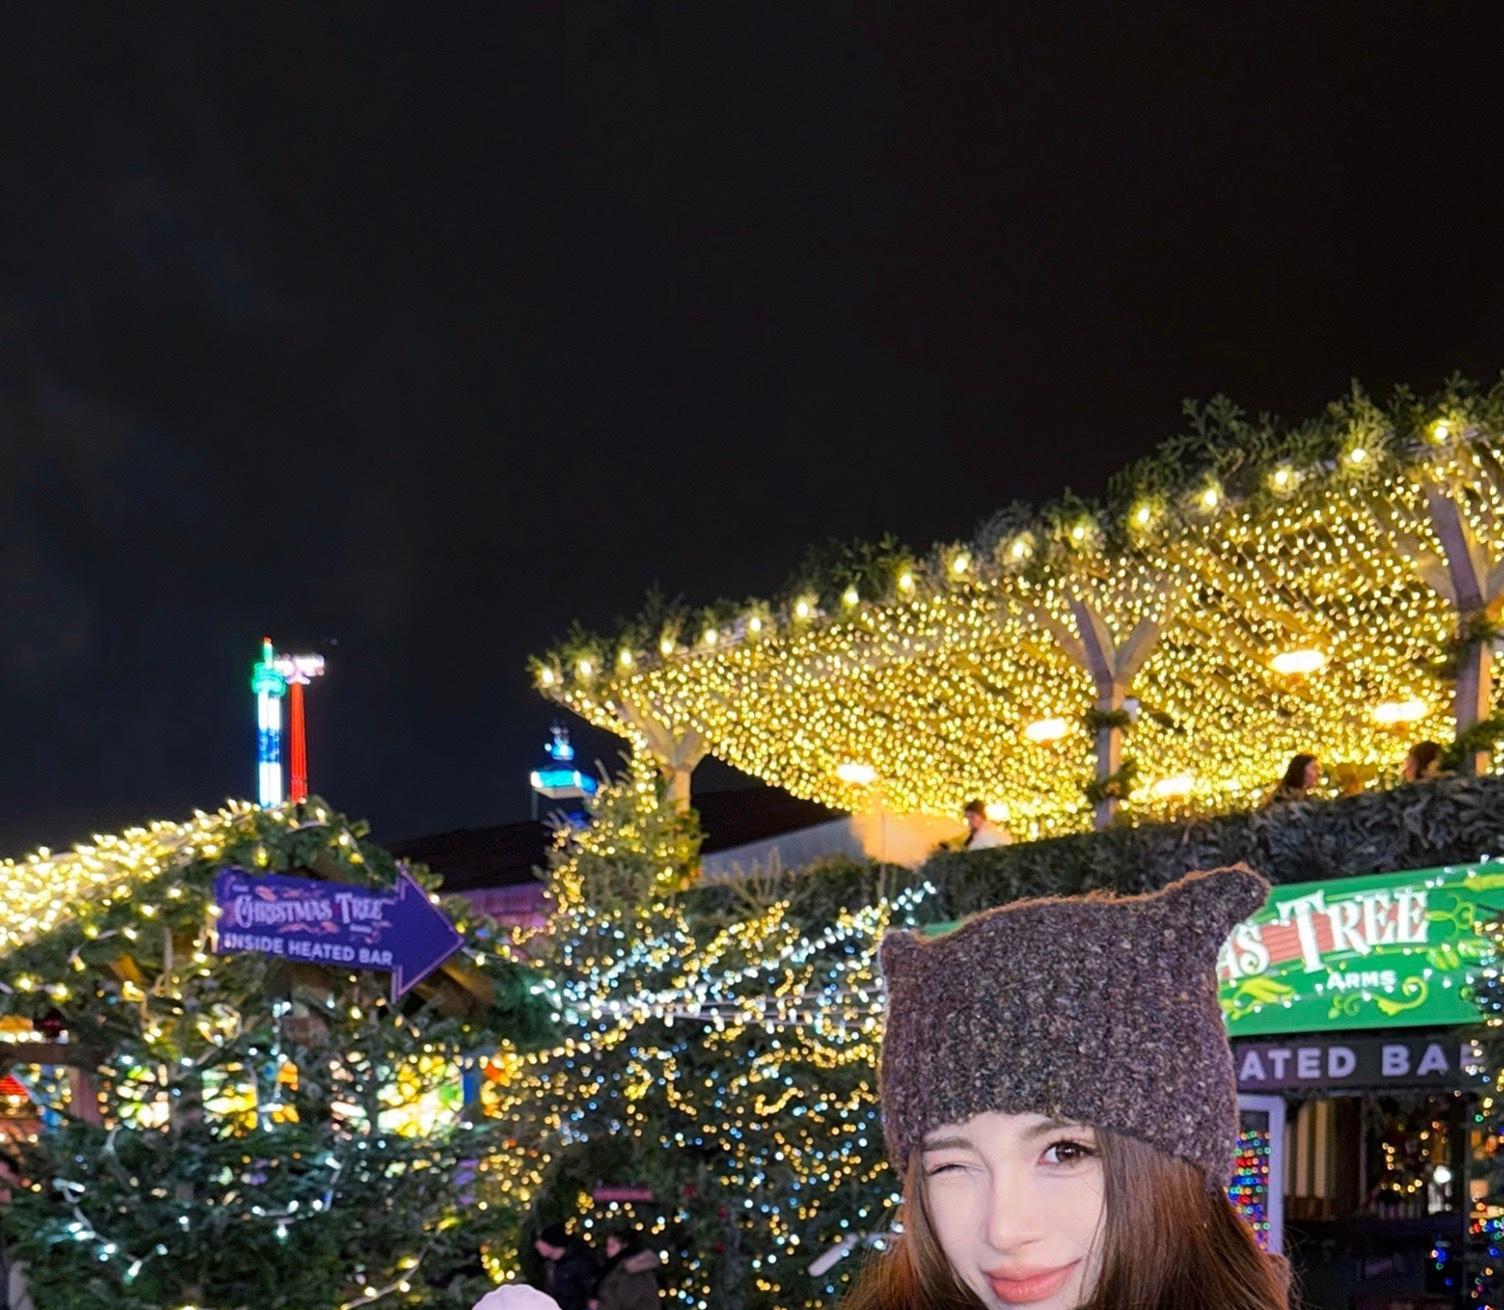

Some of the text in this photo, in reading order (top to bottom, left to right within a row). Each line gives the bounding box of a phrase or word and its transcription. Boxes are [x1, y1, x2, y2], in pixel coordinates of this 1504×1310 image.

[235, 892, 383, 928] CHRISTMAS TREE
[1275, 889, 1429, 973] TREE
[224, 933, 393, 965] INSIDE HEATED BAR
[1327, 969, 1397, 990] ARMS
